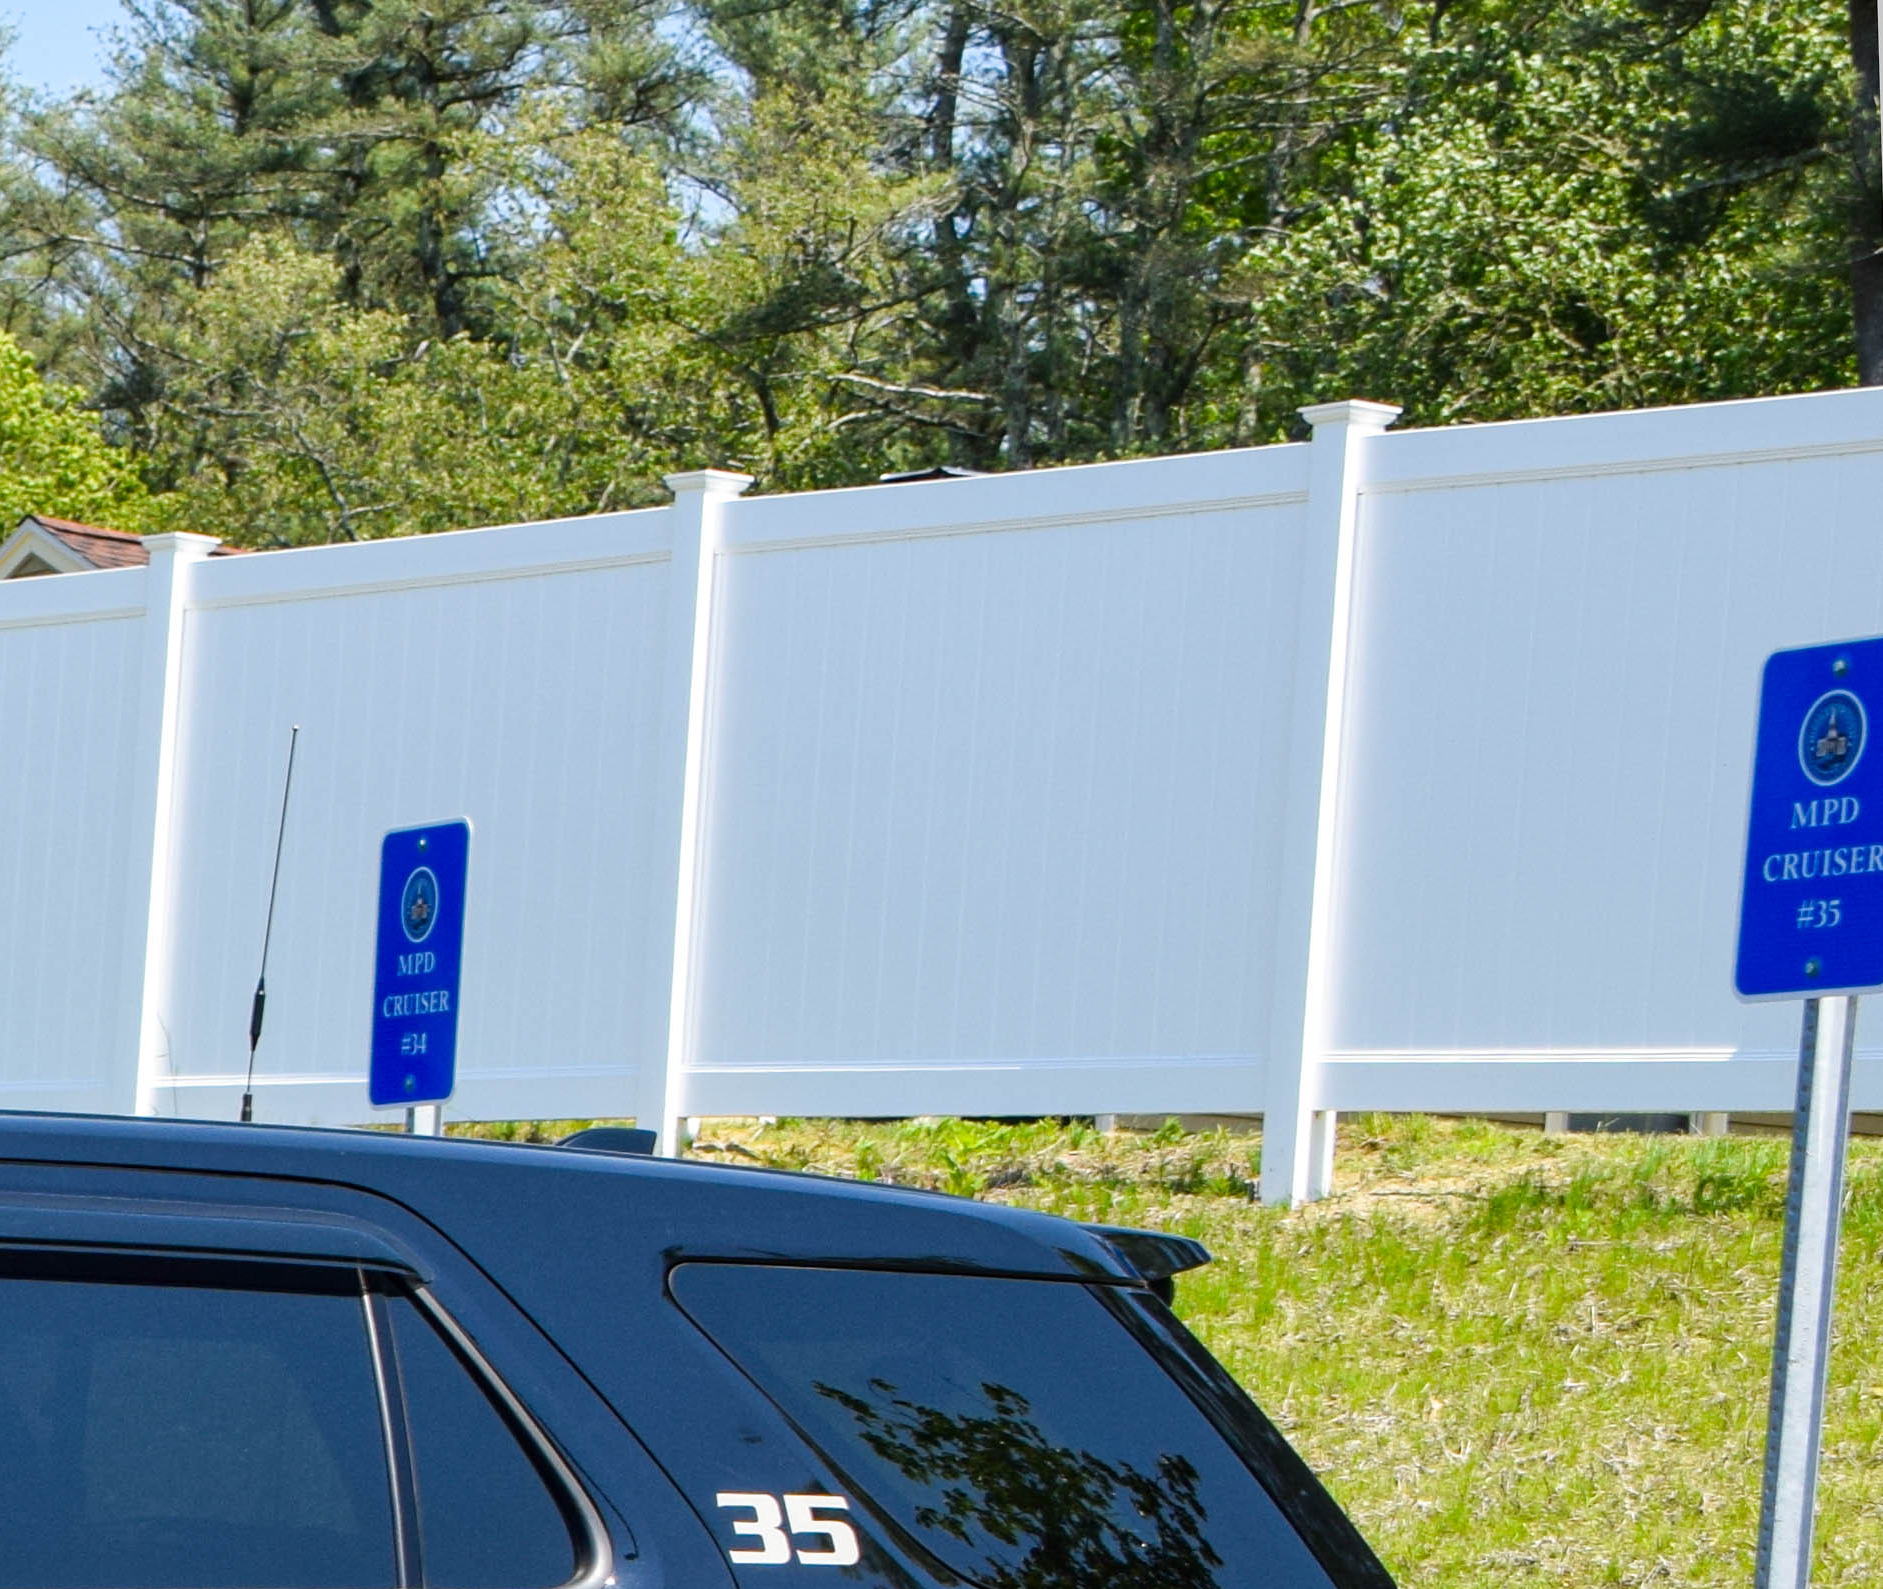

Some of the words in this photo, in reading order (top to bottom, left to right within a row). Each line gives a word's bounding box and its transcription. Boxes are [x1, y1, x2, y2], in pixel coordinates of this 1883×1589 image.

[1790, 797, 1859, 829] MPD
[1763, 844, 1883, 882] CRUISER
[1796, 900, 1841, 928] #35
[397, 951, 435, 976] MPD
[383, 990, 450, 1017] CRUISER
[715, 1492, 861, 1566] 35
